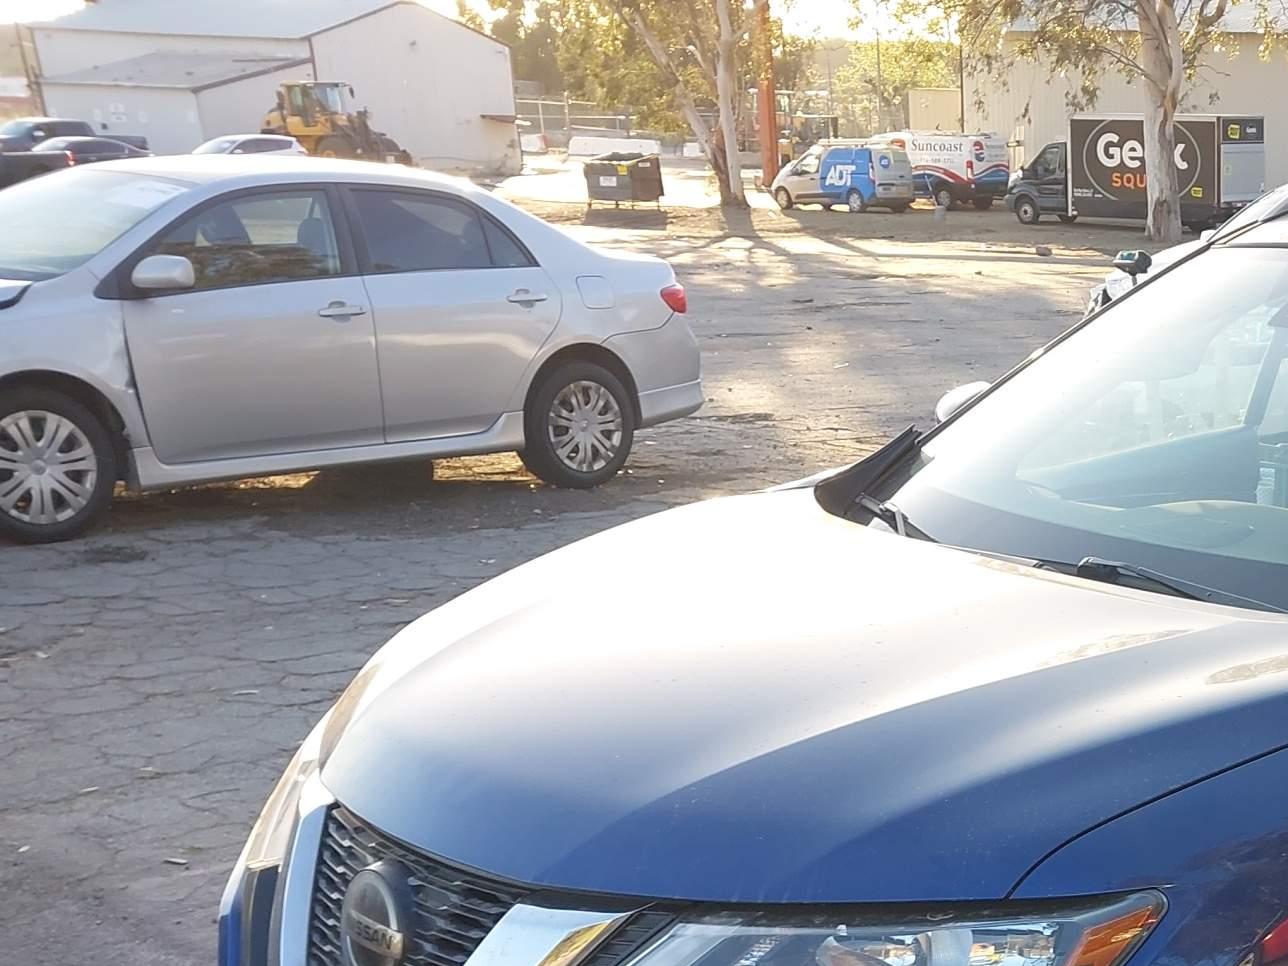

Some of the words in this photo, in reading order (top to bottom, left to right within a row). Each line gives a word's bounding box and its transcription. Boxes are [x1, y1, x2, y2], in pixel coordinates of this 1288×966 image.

[911, 139, 964, 153] Suncoast
[1096, 132, 1189, 170] Gek
[825, 164, 857, 187] ADT
[1111, 172, 1148, 188] SQU
